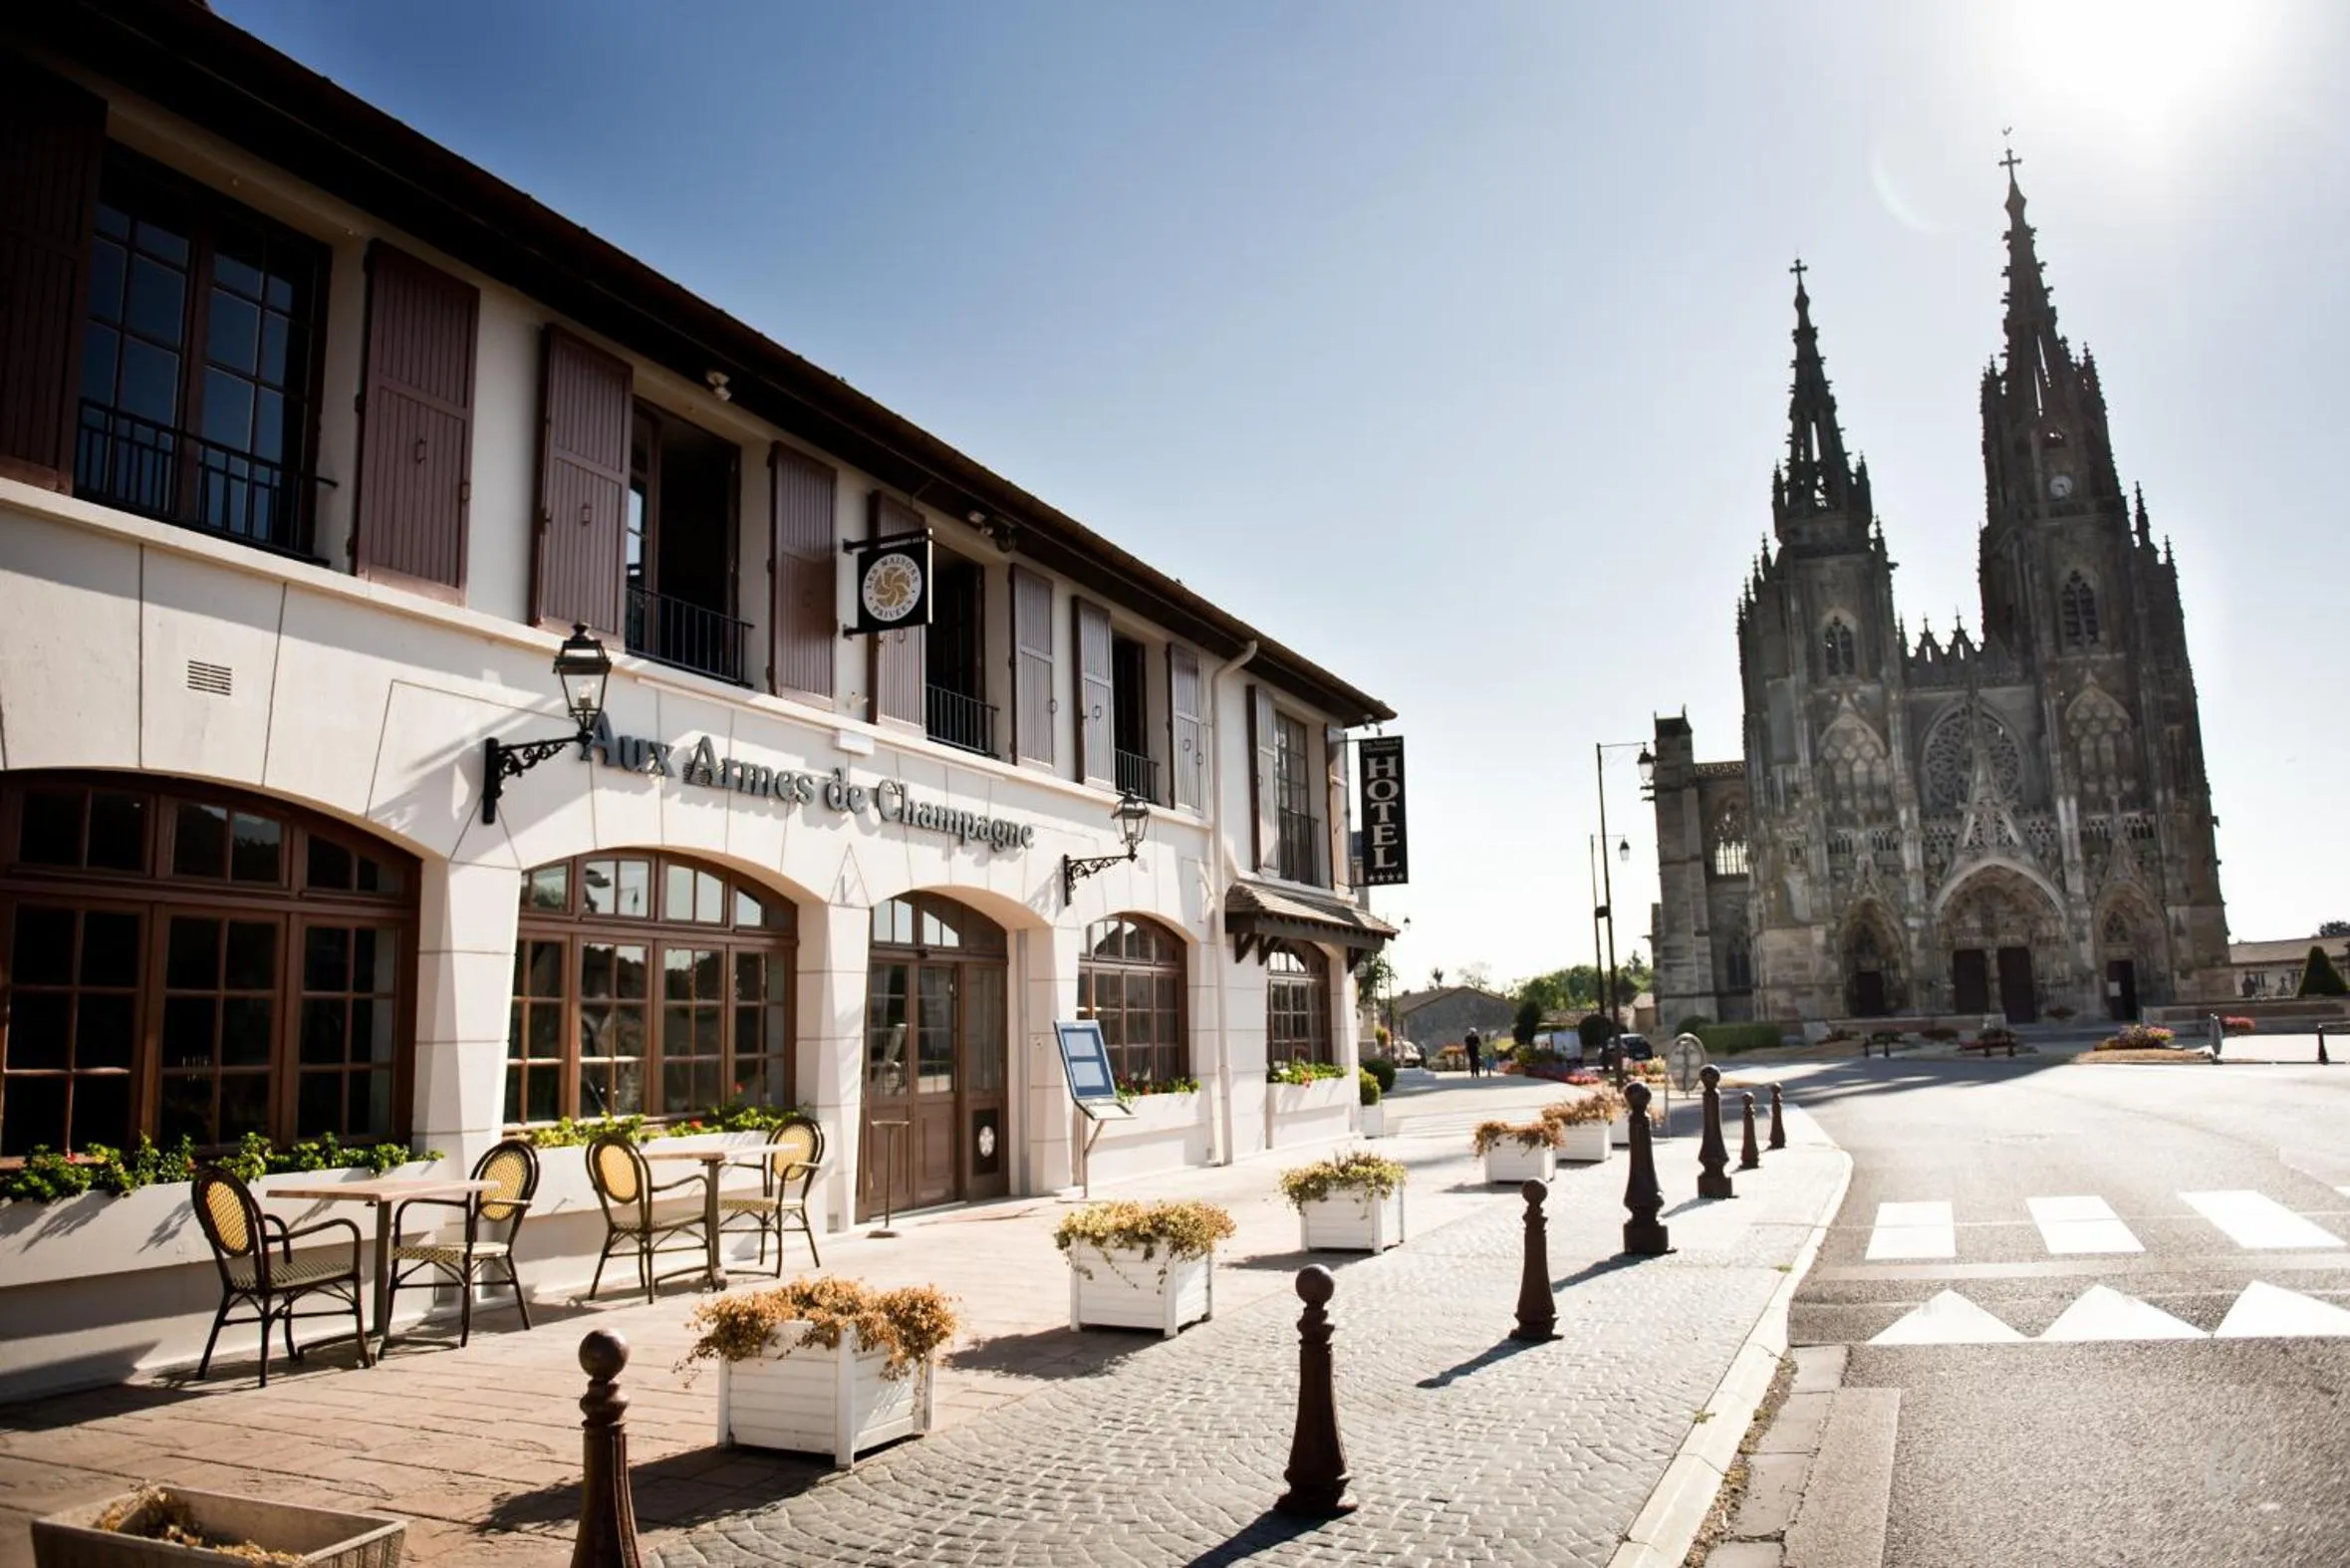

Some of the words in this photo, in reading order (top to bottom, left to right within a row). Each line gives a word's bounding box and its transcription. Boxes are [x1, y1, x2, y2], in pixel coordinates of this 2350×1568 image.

[581, 710, 676, 778] Aux
[681, 735, 815, 806] Armes
[826, 767, 869, 815] de
[875, 779, 1035, 853] Champagne
[1366, 755, 1400, 869] HOTEL
